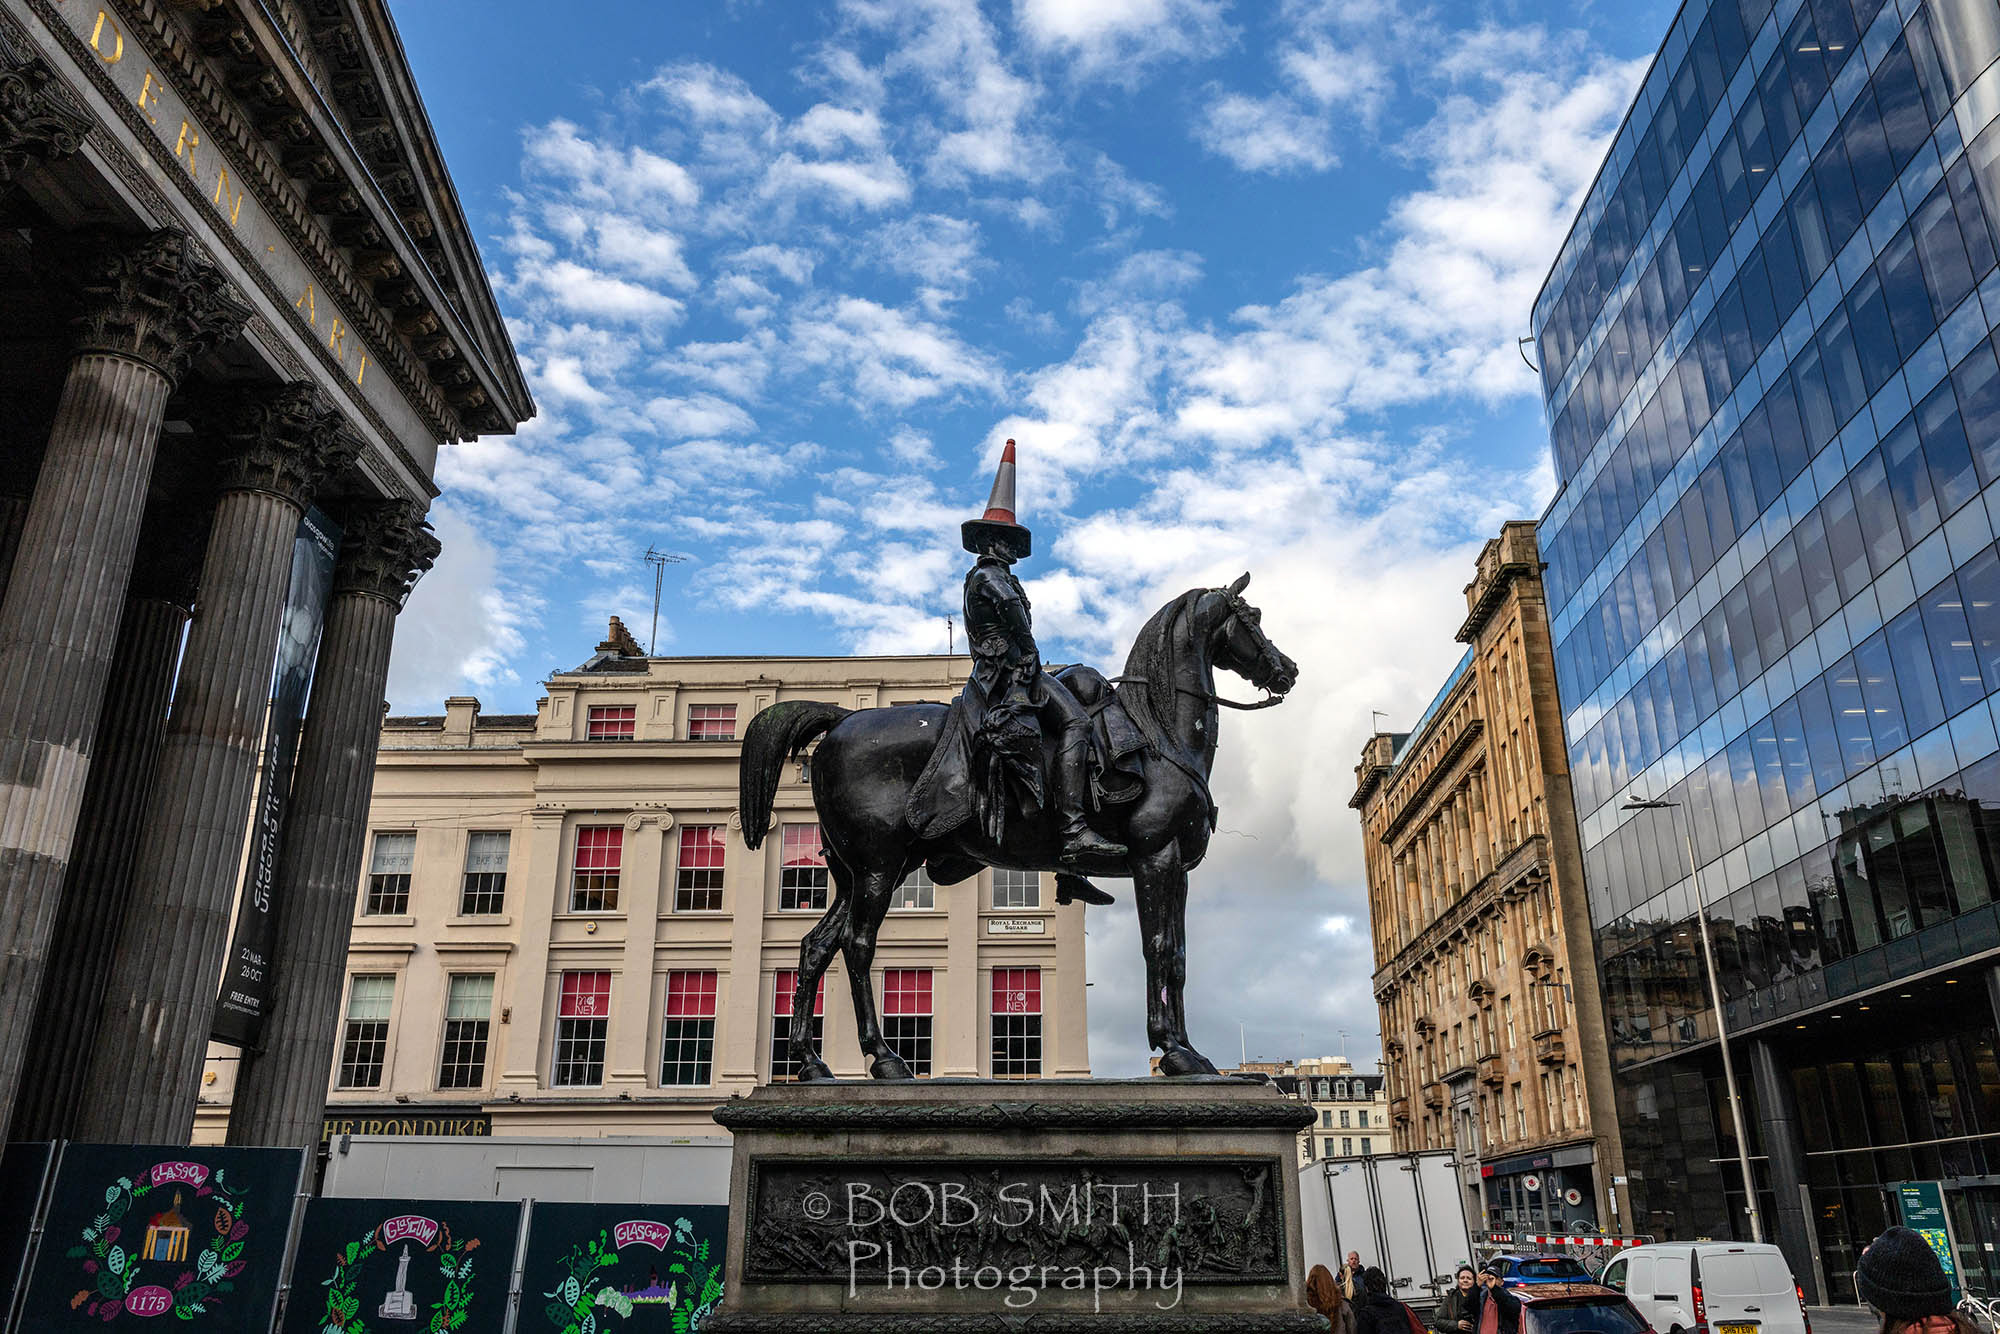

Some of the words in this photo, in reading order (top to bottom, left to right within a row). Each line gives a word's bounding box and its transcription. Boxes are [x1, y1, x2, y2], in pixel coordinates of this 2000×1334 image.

[57, 0, 245, 226] DERN
[296, 283, 373, 385] ART
[254, 832, 268, 908] Clara
[259, 817, 278, 914] Undoing
[241, 947, 250, 960] 22
[240, 965, 251, 978] 26
[250, 968, 263, 982] OCT
[229, 990, 244, 1003] FREE
[243, 995, 260, 1008] ENTRY
[321, 1119, 354, 1142] HE
[358, 1119, 417, 1136] IRON
[421, 1119, 487, 1136] DUKE
[130, 1295, 167, 1311] 1175
